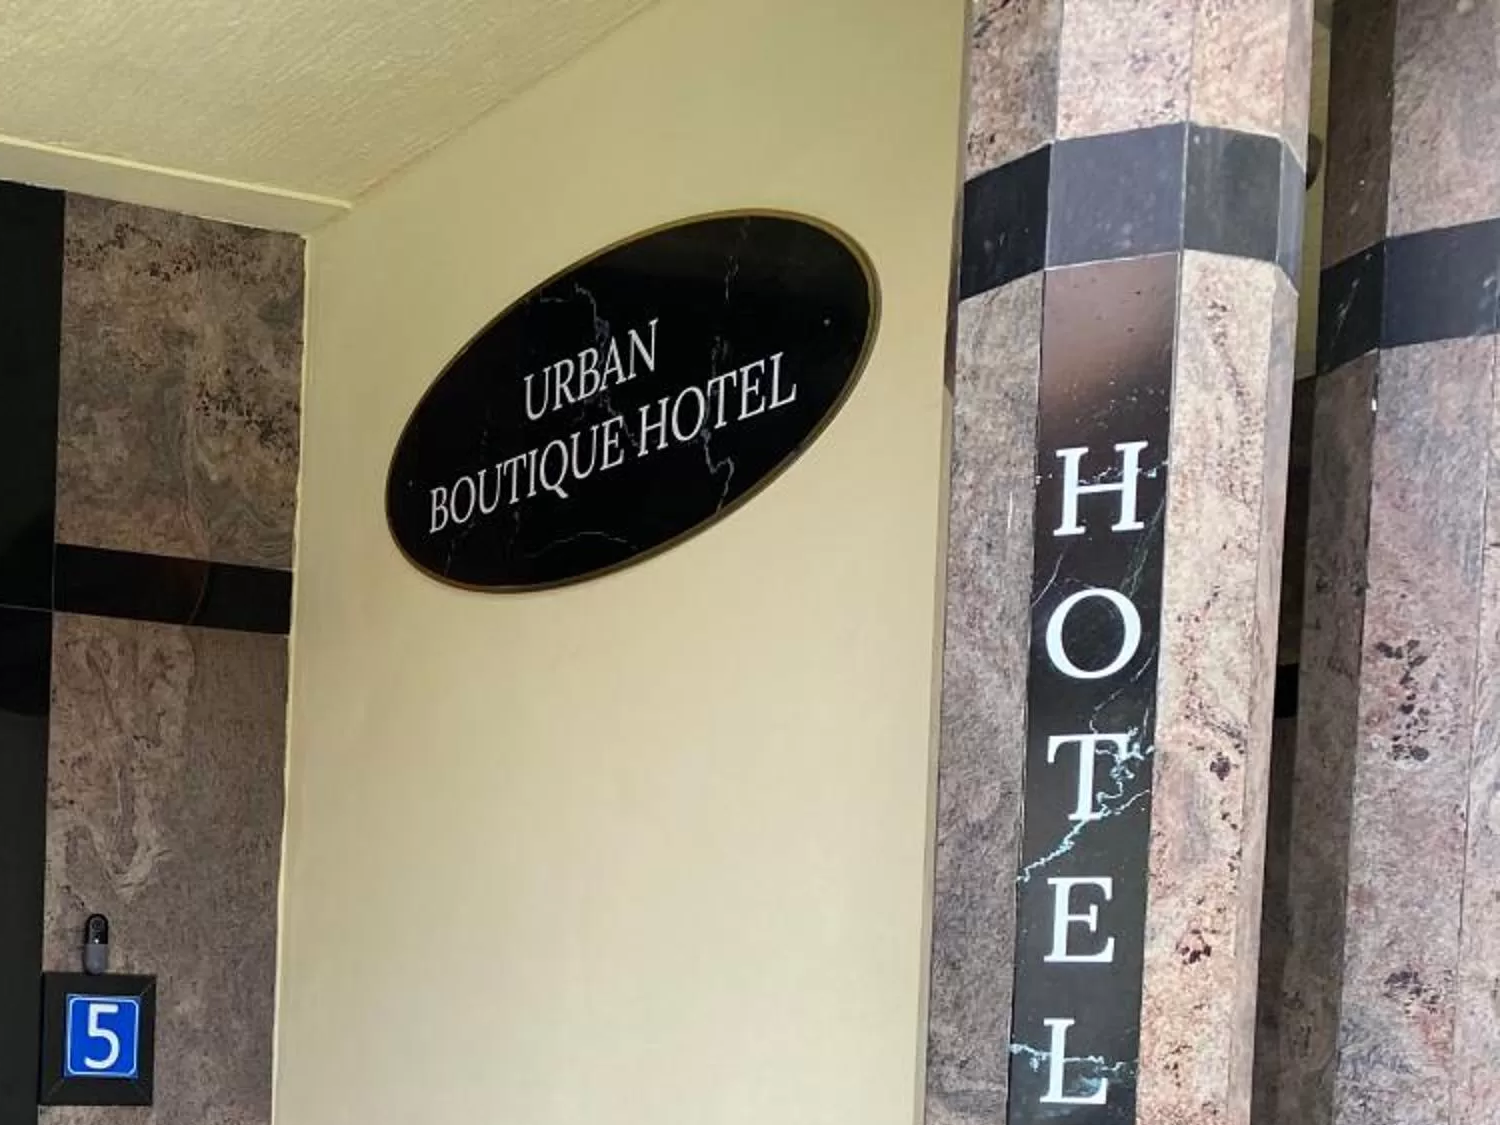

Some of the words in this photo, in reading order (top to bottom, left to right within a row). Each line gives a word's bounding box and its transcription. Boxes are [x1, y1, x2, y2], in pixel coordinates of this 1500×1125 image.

[523, 318, 660, 421] URBAN
[428, 414, 626, 534] BOUTIQUE
[637, 351, 798, 459] HOTEL
[1038, 440, 1149, 1106] HOTEL
[84, 1003, 121, 1070] 5
